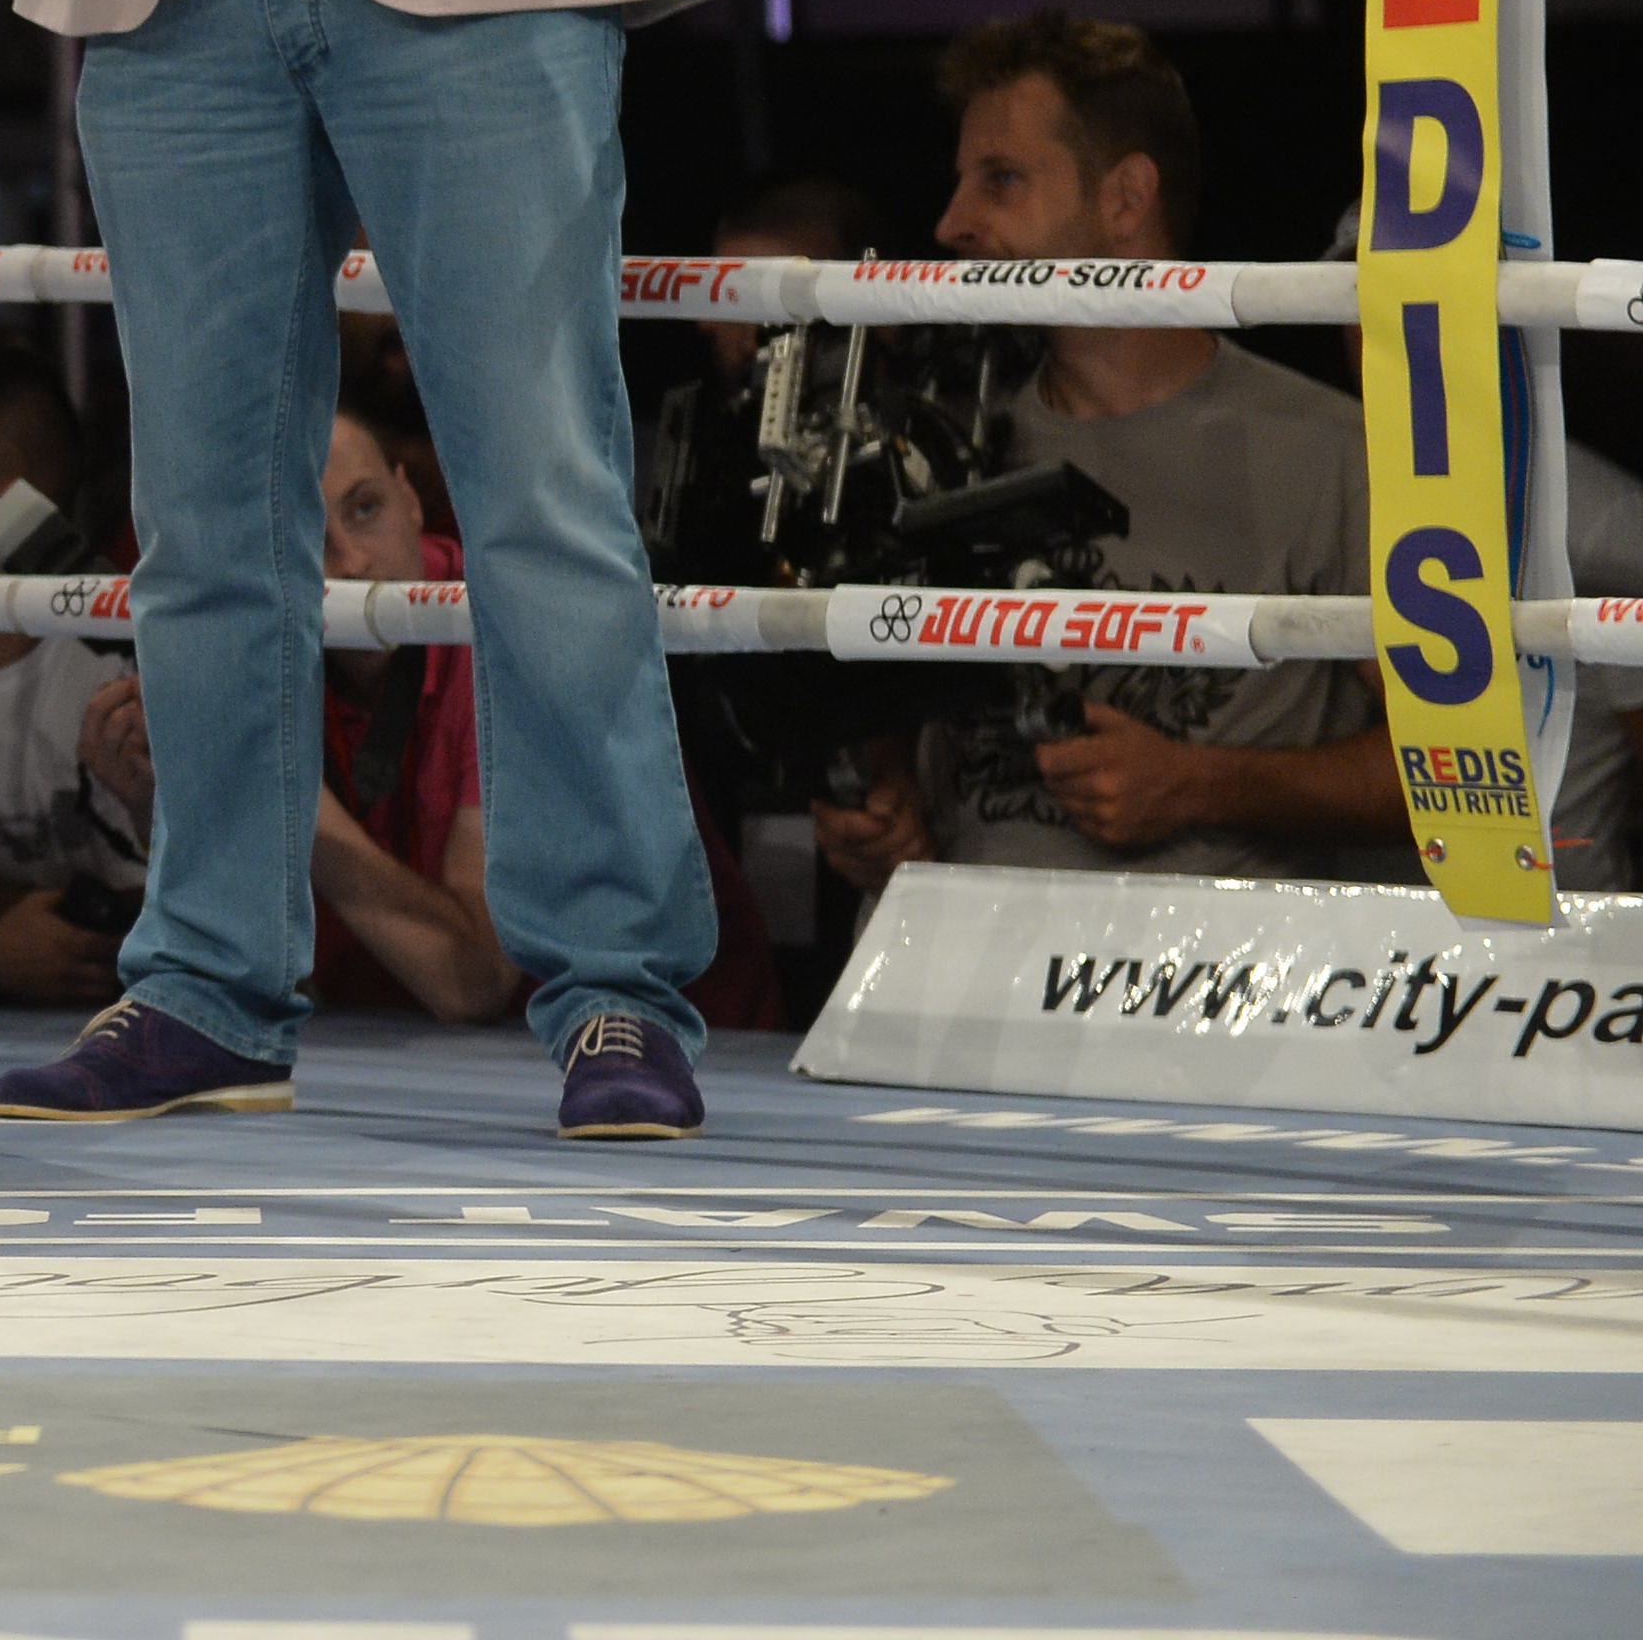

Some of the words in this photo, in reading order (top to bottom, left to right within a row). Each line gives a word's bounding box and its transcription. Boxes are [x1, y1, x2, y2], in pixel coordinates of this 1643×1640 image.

[917, 596, 1060, 648] AUTO
[1062, 601, 1208, 652] SOFT
[1400, 746, 1526, 785] REDIS
[1411, 787, 1531, 818] NUTRITIE
[385, 1205, 1451, 1233] SWAT
